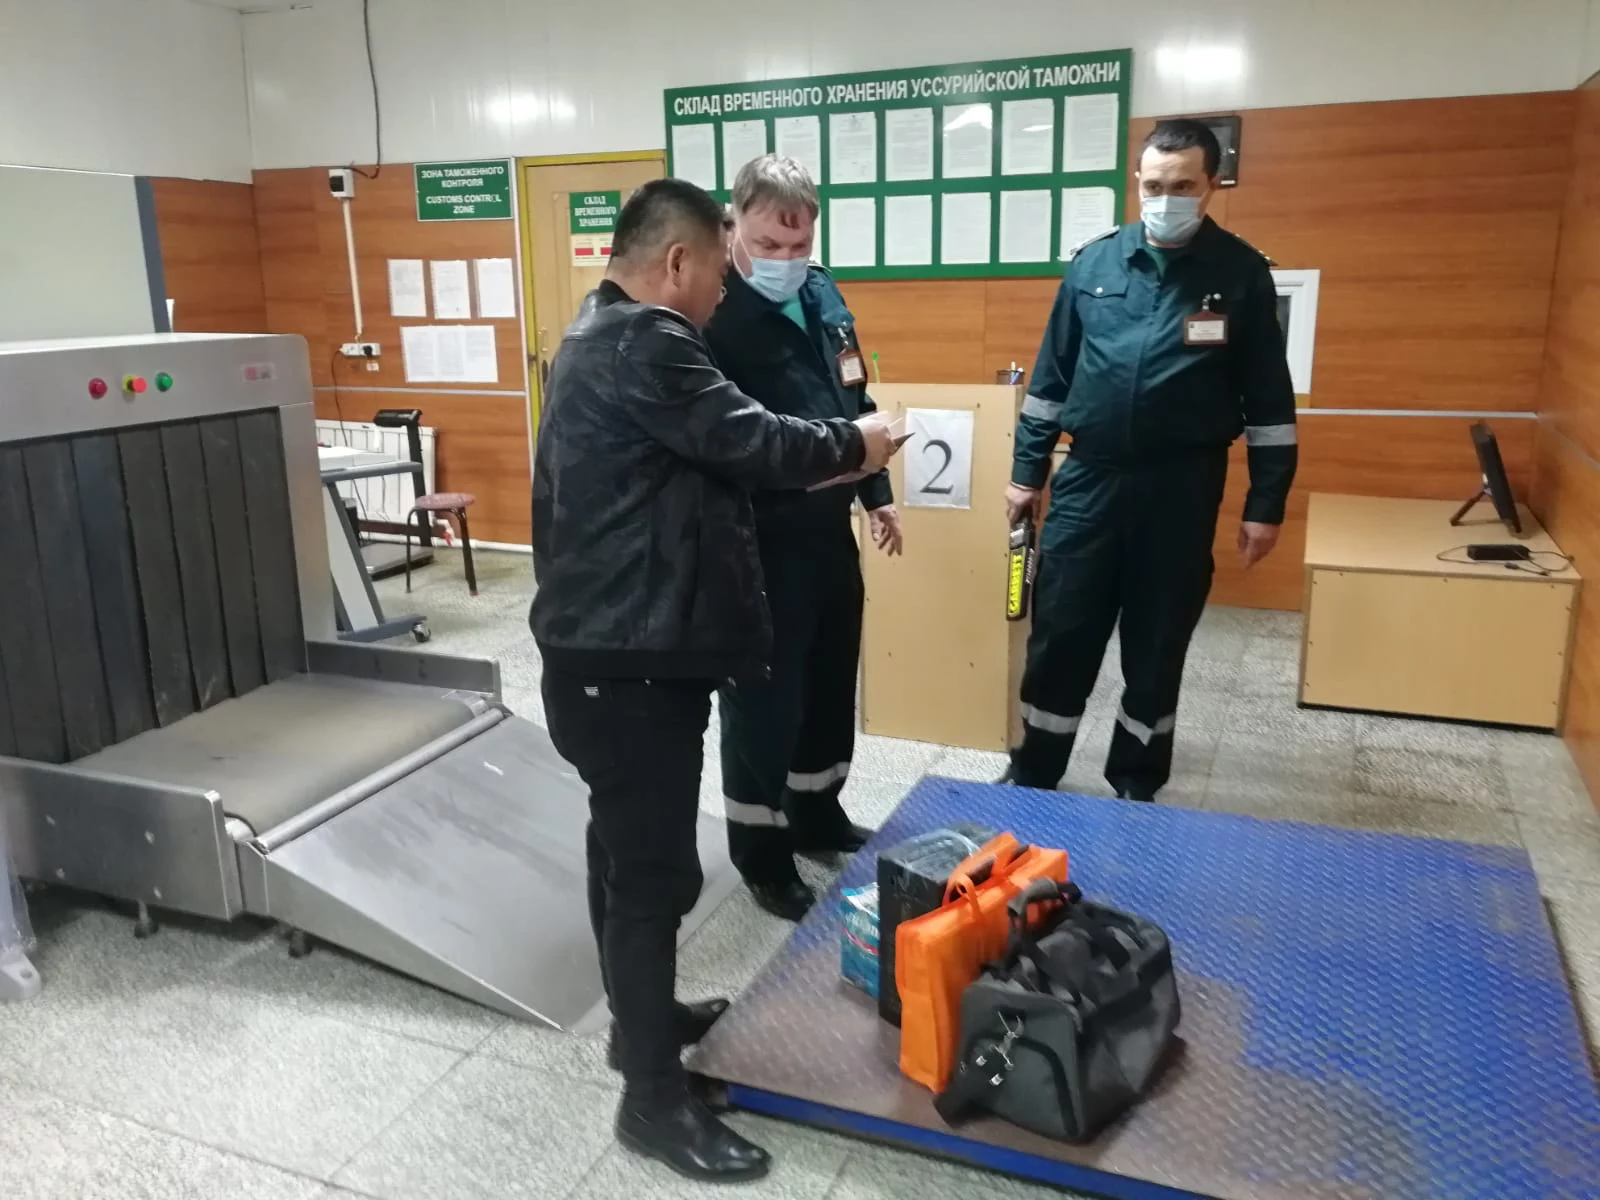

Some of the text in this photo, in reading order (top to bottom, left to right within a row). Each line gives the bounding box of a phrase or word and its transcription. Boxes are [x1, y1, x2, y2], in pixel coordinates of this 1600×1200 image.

[674, 61, 1120, 116] СКЛАД ВРЕМЕННОГО ХРАНЕНИЯ УССУРИЙСКОЙ ТАМОЖНИ
[421, 166, 504, 179] ЗОНА ТАМОЖЕННОГО
[441, 178, 484, 188] КОНТРОЛЯ
[425, 194, 464, 204] CUSTOMS
[453, 205, 475, 214] ZONE
[920, 439, 954, 495] 2
